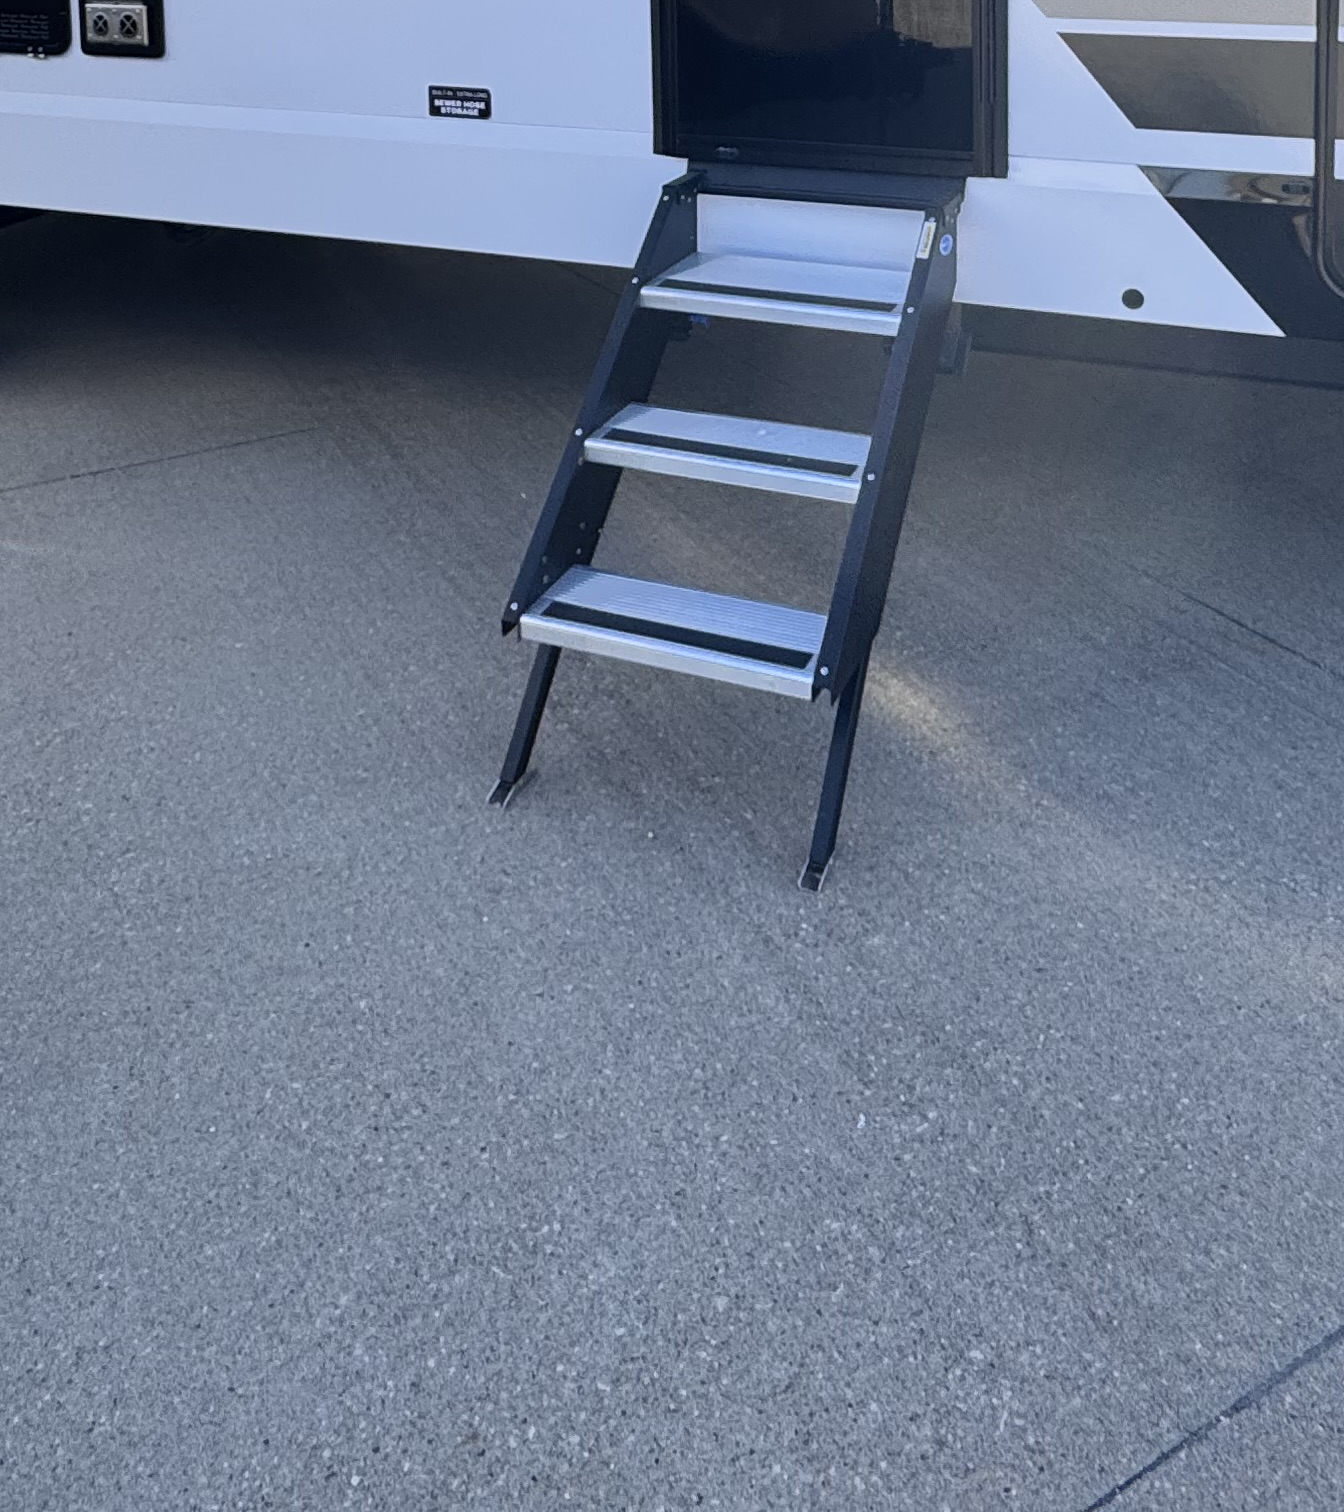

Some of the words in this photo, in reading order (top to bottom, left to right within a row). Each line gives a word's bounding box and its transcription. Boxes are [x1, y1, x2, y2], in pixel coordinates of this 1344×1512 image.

[434, 98, 462, 107] SEWER
[463, 100, 486, 109] HOSE
[440, 107, 480, 116] STORAGE
